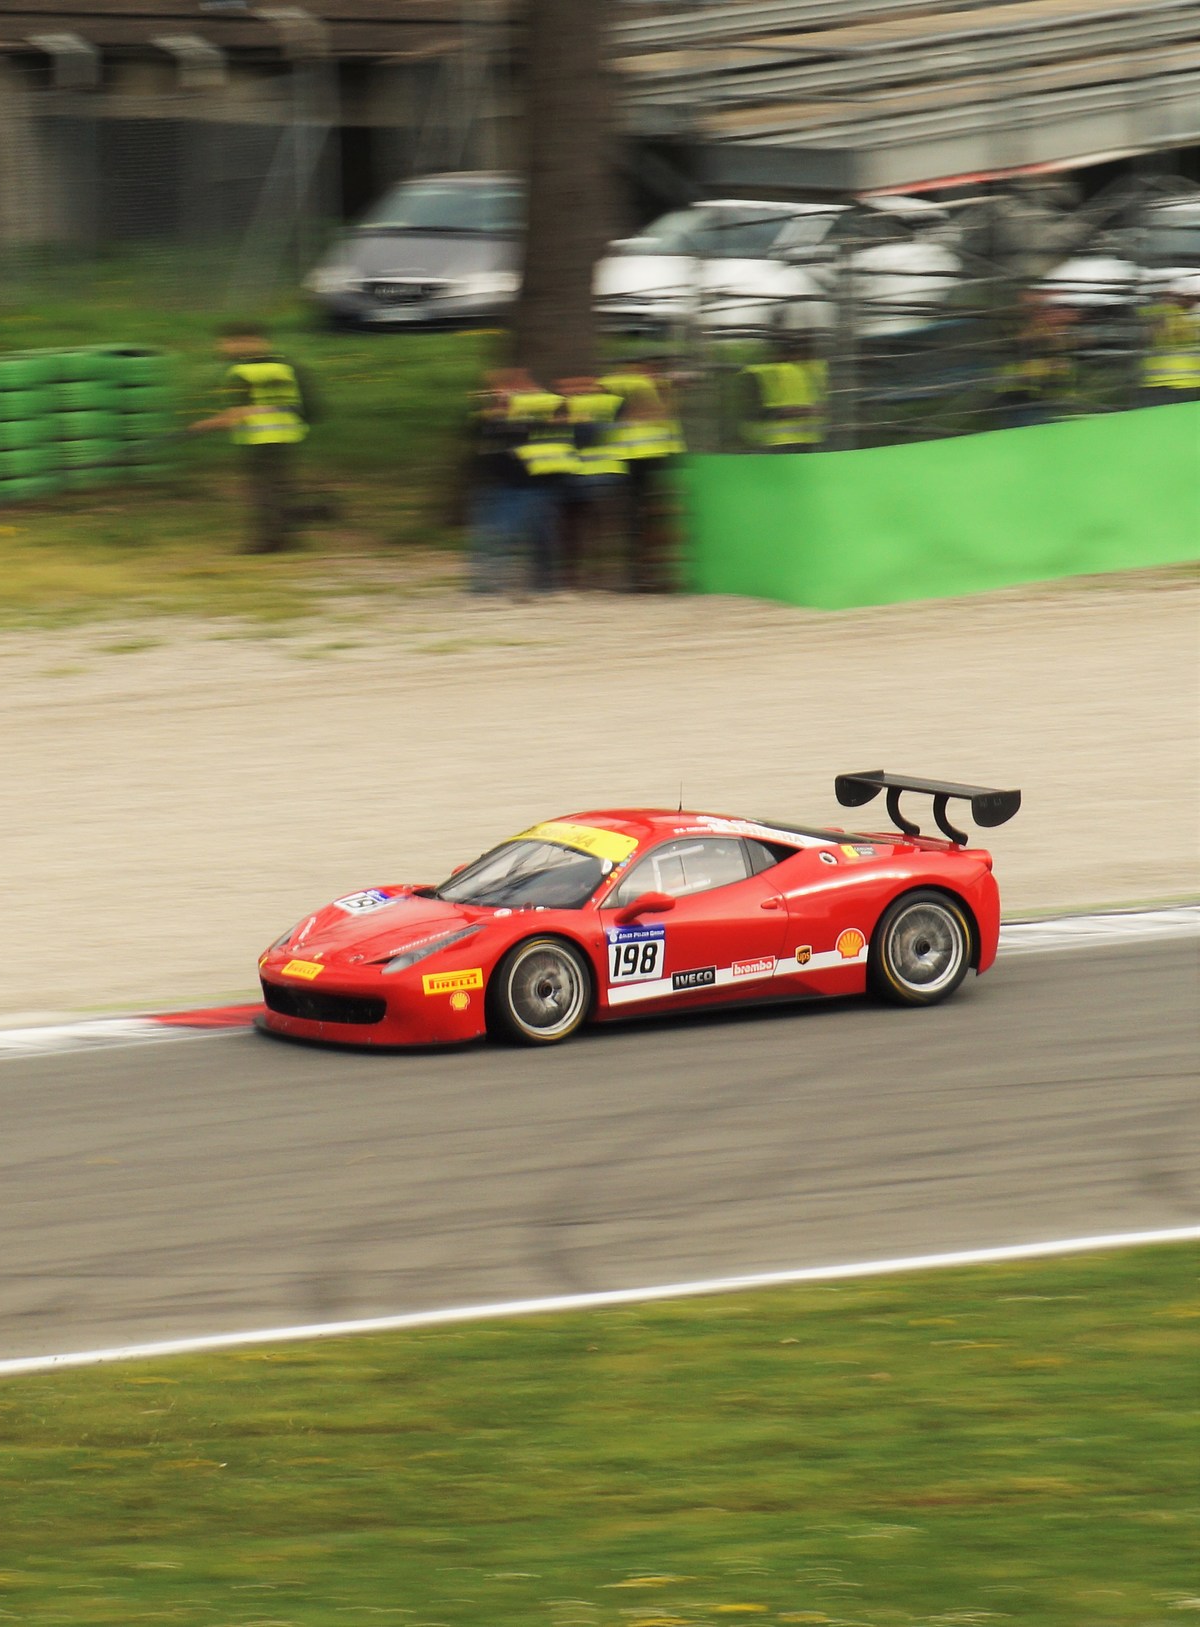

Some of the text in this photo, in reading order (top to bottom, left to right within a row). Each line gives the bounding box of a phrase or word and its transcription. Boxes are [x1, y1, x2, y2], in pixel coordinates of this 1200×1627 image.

[613, 942, 658, 977] 198
[733, 960, 773, 976] brembo
[428, 973, 477, 990] PIRELLI
[675, 970, 713, 987] IVECO
